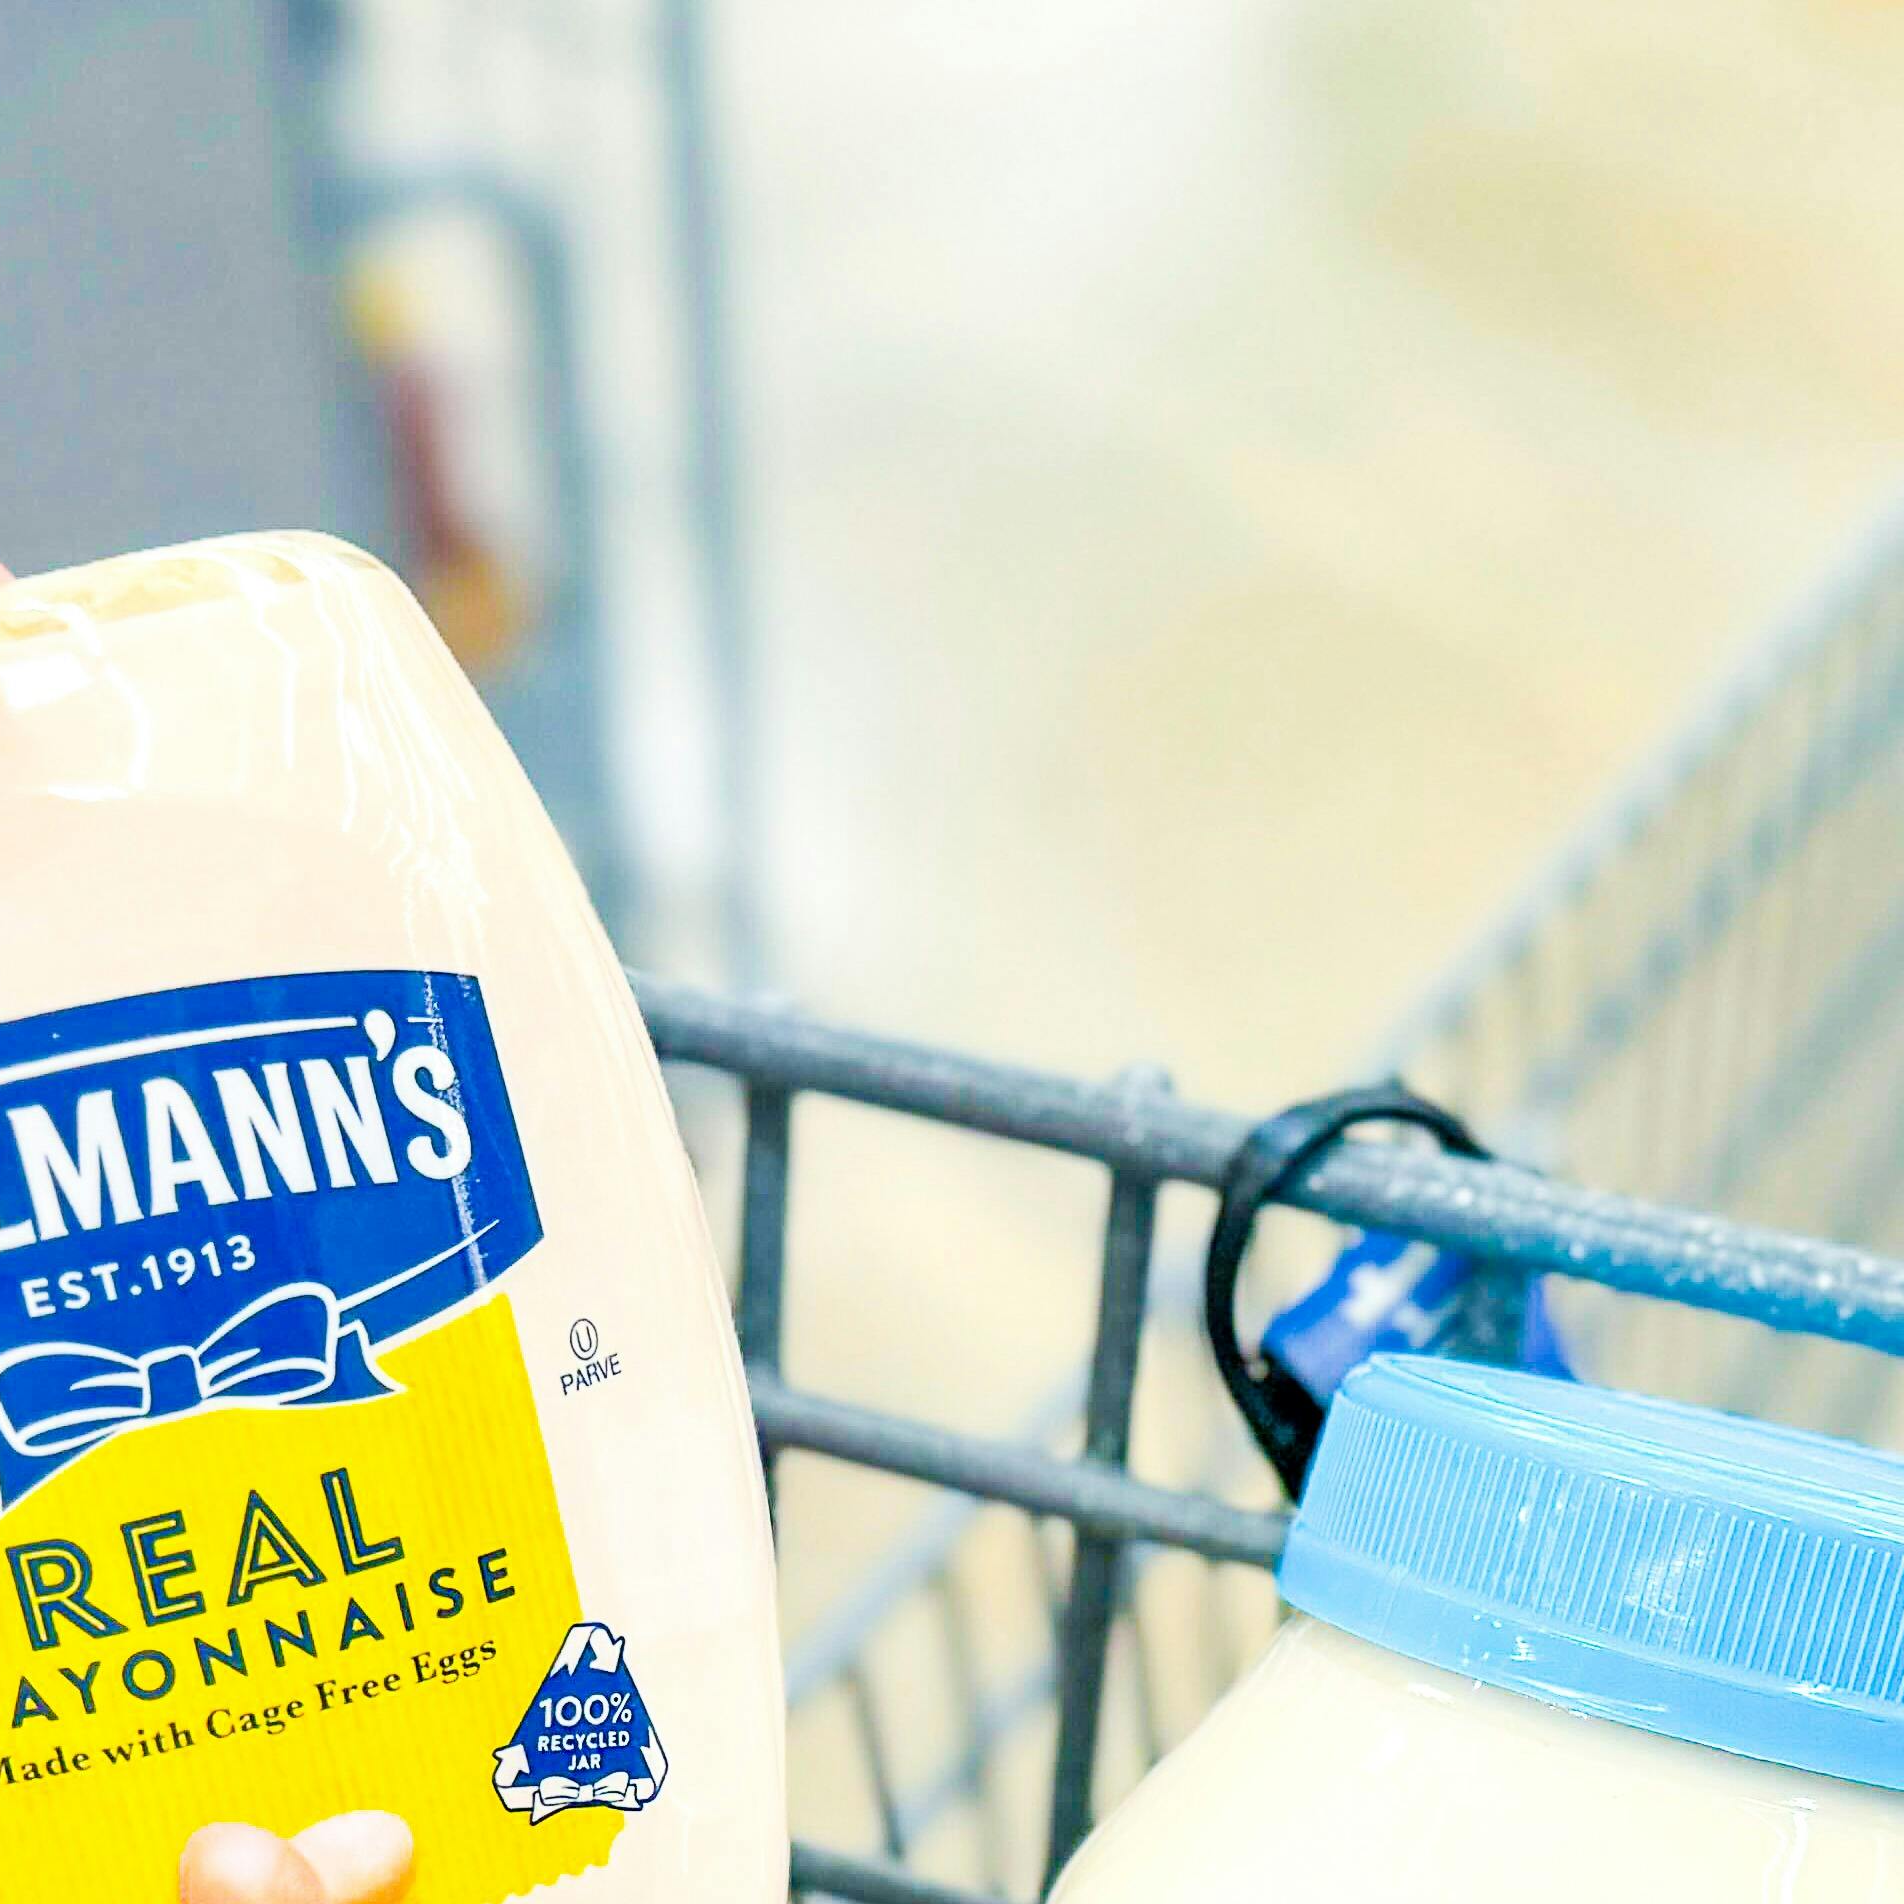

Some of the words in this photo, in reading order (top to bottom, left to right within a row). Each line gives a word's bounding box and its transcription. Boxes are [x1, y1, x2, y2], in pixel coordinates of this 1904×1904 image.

[560, 1353, 622, 1396] PARVE
[5, 1466, 405, 1652] REAL
[101, 1721, 195, 1767] with
[207, 1700, 305, 1736] Cage
[315, 1669, 402, 1713] Free
[411, 1639, 498, 1685] Eggs
[538, 1692, 633, 1728] 100%
[537, 1731, 630, 1752] RECYCLED
[568, 1753, 601, 1771] JAR
